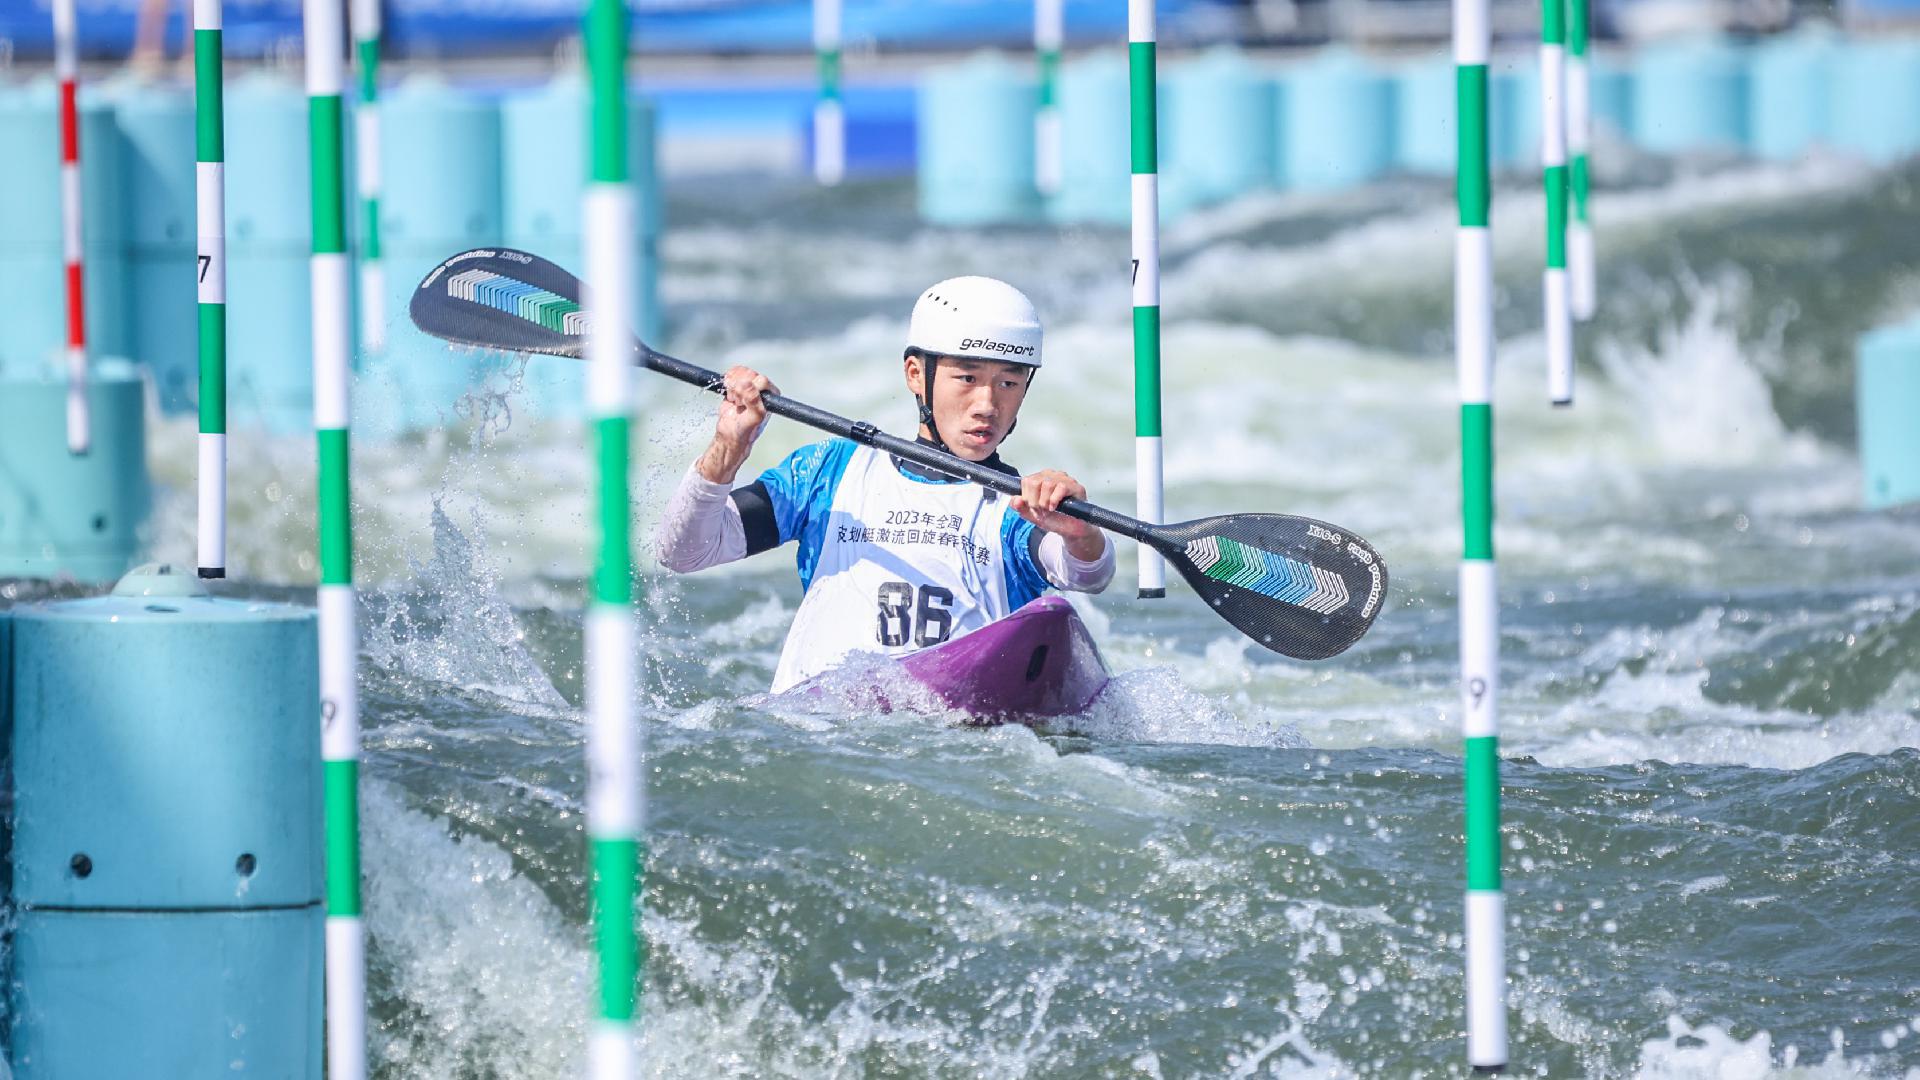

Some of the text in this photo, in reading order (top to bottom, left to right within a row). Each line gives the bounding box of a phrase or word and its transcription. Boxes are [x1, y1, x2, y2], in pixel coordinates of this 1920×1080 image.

[198, 255, 211, 283] 7
[959, 338, 1035, 357] galasport
[885, 510, 963, 532] 2023年全国
[1307, 524, 1342, 545] X16-S
[1347, 542, 1382, 618] raab paddles
[876, 581, 954, 649] 86
[1470, 677, 1486, 711] 9
